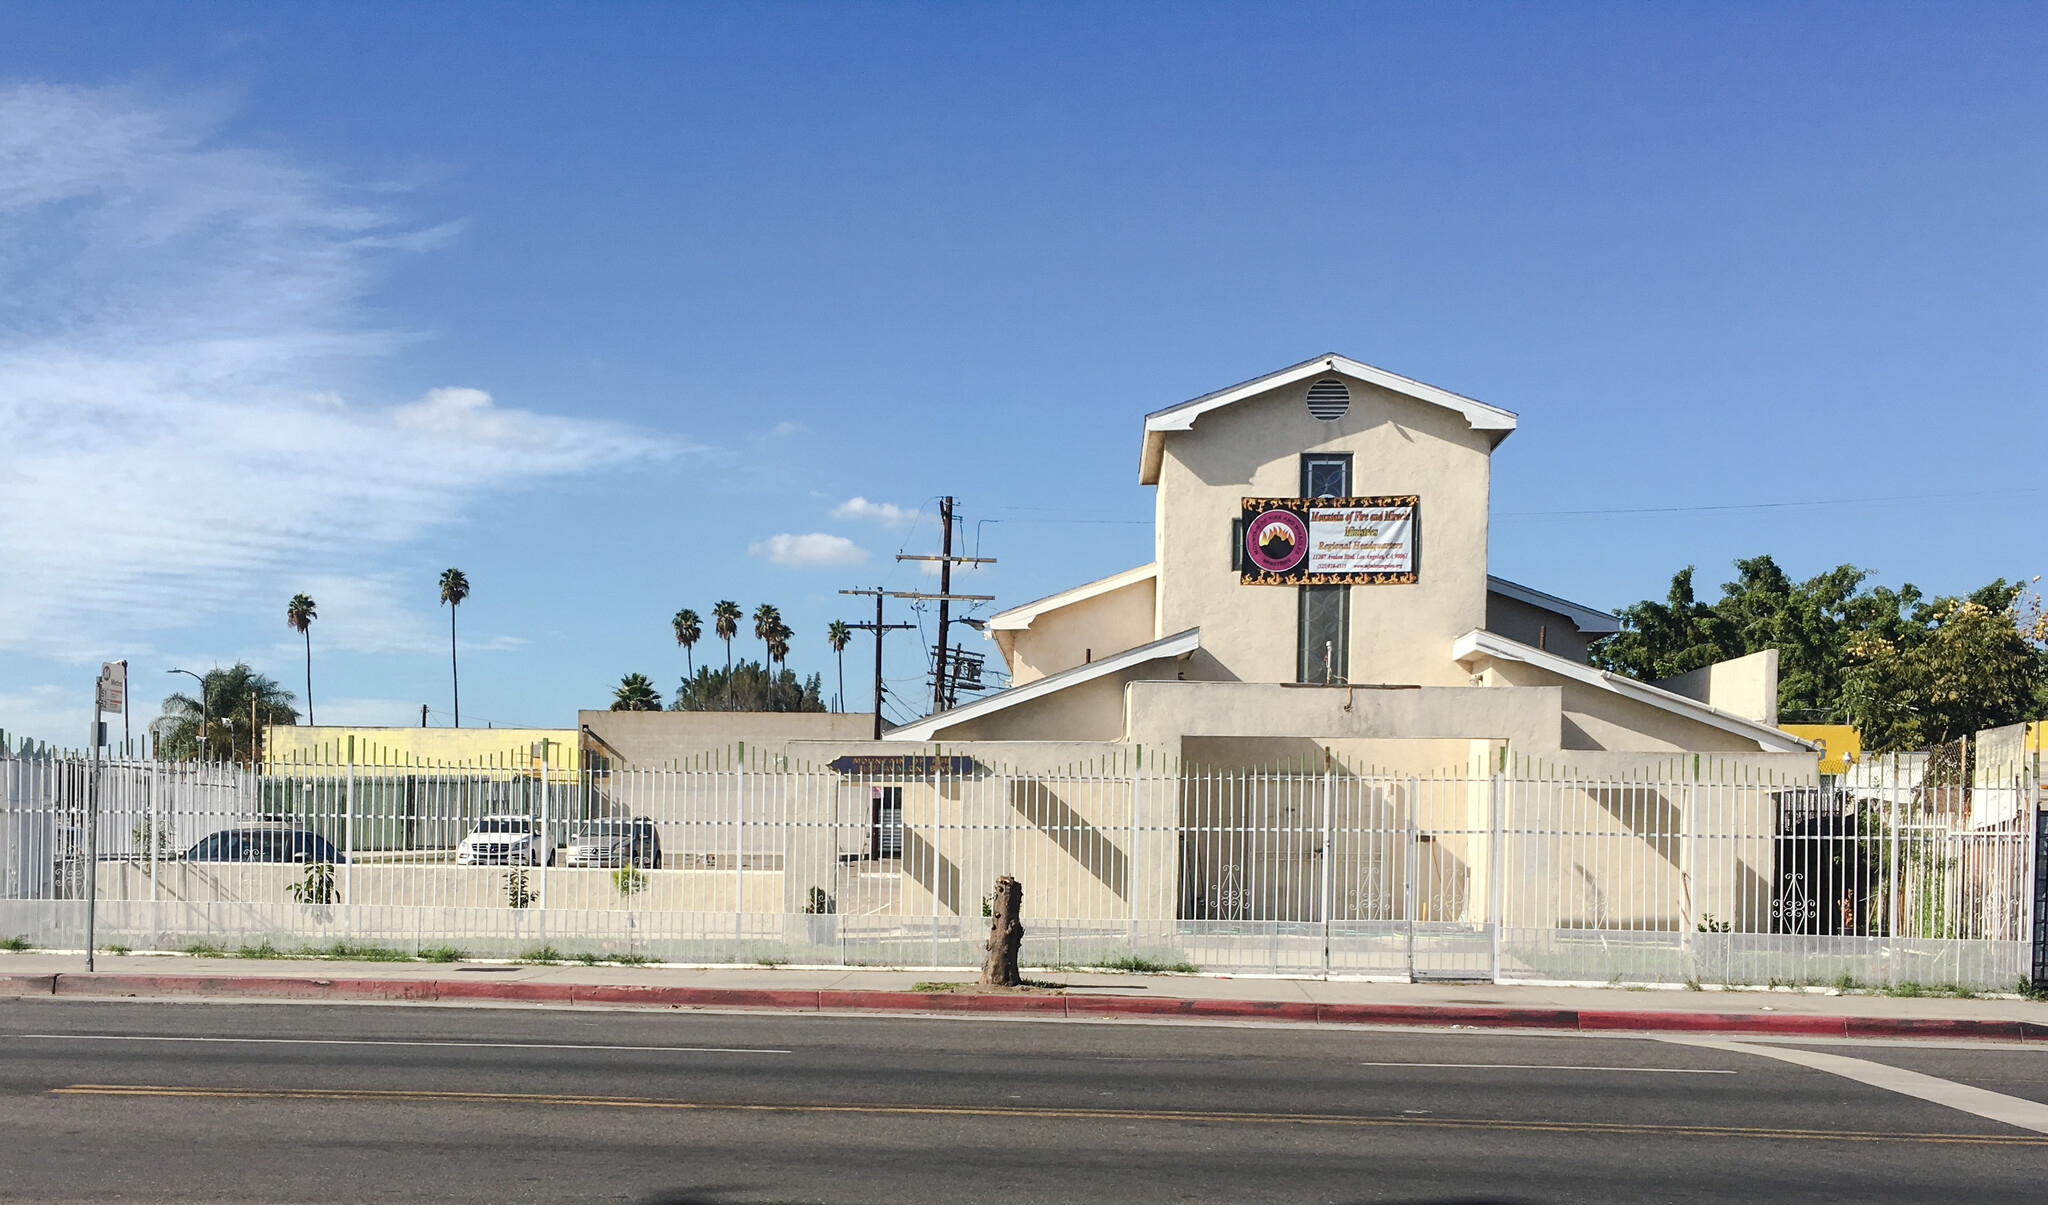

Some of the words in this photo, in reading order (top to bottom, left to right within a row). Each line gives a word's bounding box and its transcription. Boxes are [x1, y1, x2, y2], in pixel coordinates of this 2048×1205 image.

[1283, 516, 1295, 525] AND
[1311, 511, 1344, 522] Mountain
[1345, 511, 1354, 524] of
[1354, 511, 1369, 522] Fire
[1370, 511, 1383, 522] and
[1344, 526, 1378, 537] Ministries
[1318, 541, 1351, 552] Regional
[1353, 541, 1403, 551] Headquarters
